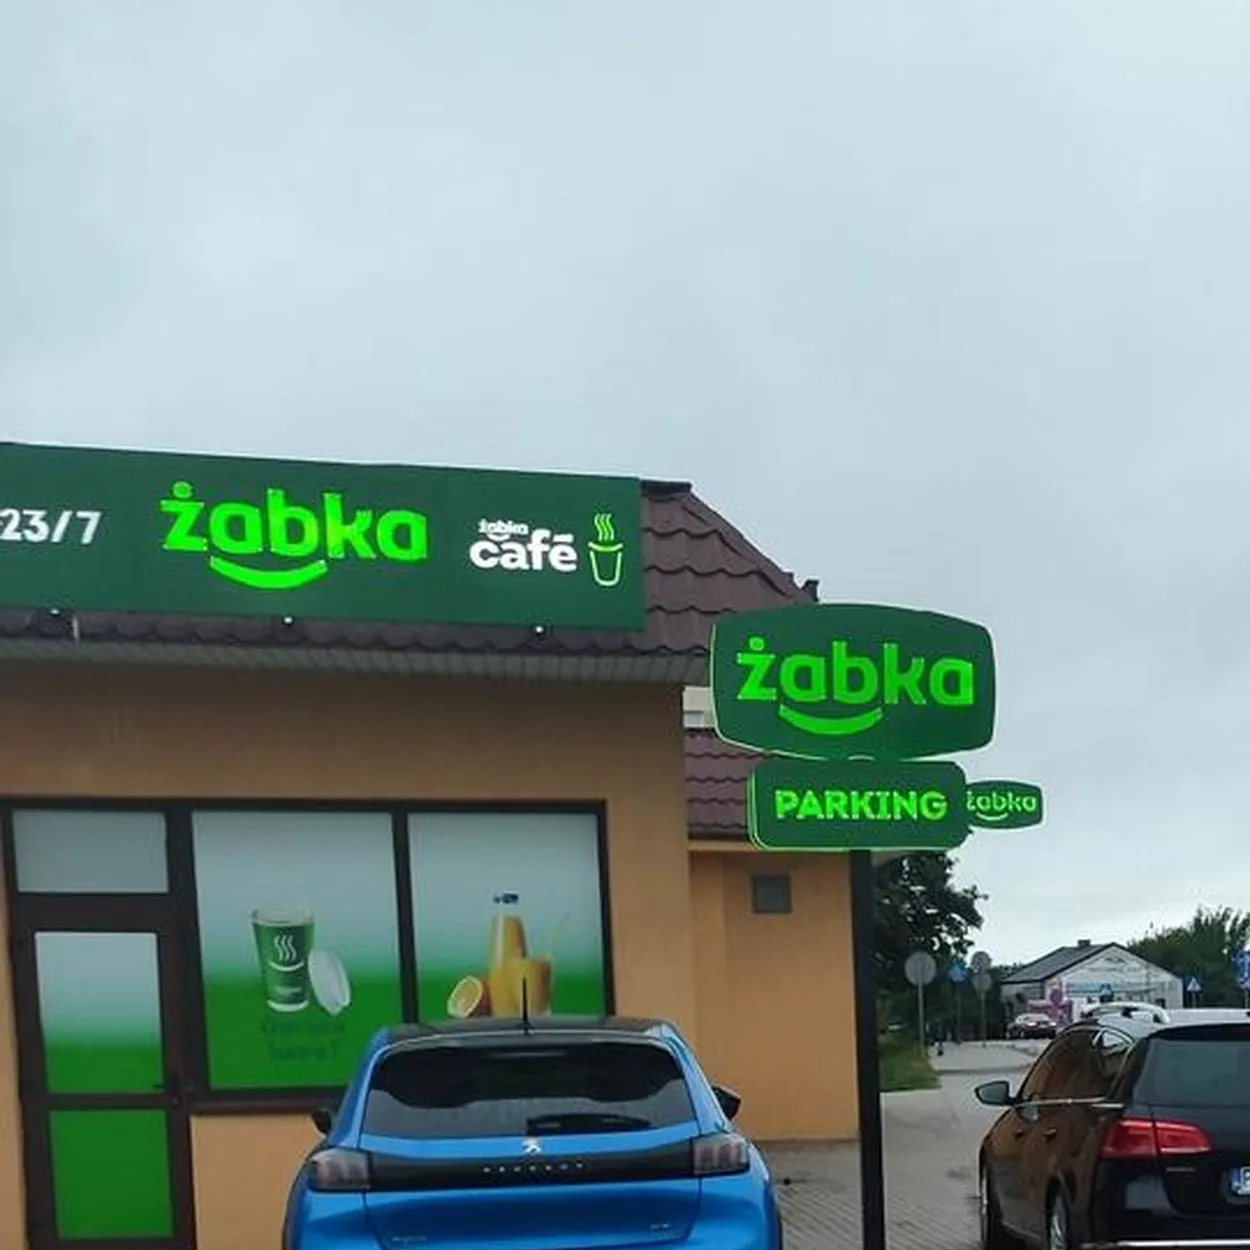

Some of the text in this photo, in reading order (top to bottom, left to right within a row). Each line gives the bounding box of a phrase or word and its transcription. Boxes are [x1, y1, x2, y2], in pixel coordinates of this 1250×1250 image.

[160, 481, 428, 562] żabka
[469, 528, 578, 572] café
[737, 636, 975, 706] żabka
[774, 789, 948, 821] PARKING
[966, 790, 1037, 812] żabka
